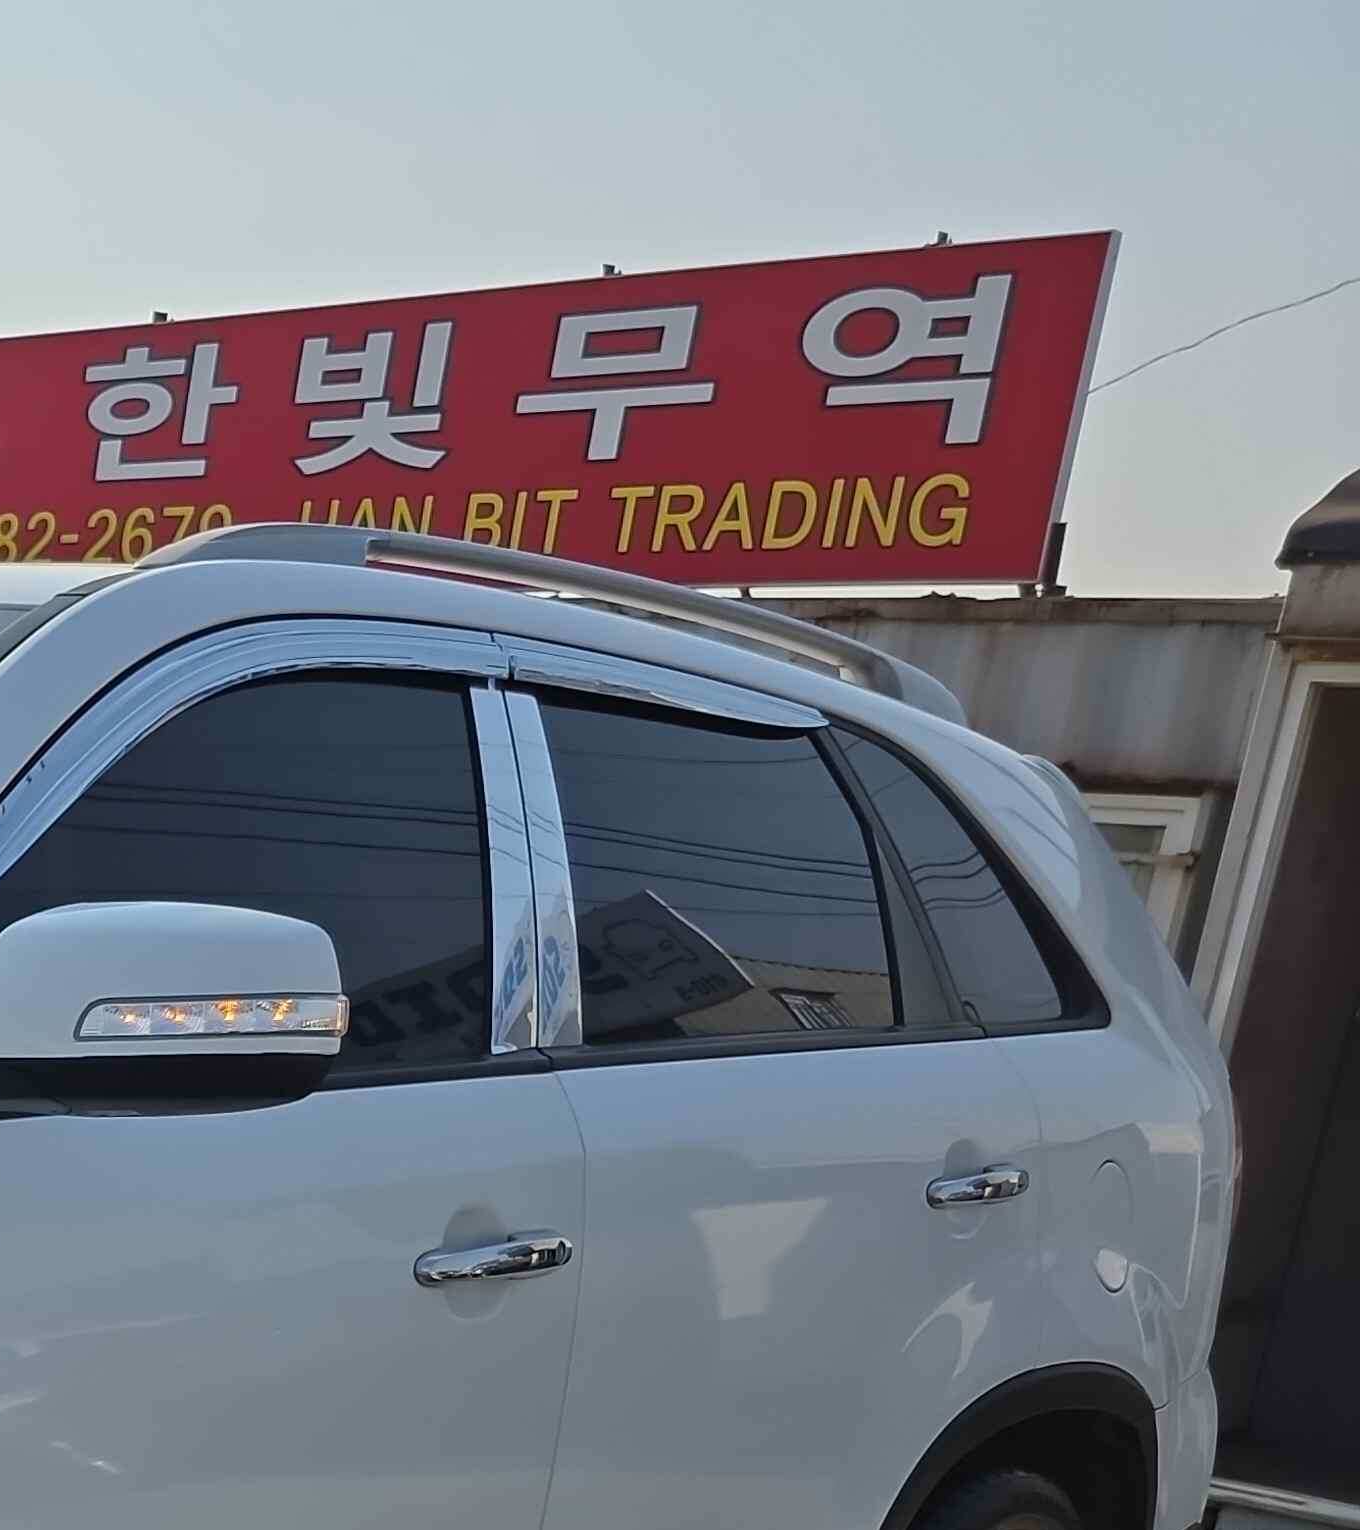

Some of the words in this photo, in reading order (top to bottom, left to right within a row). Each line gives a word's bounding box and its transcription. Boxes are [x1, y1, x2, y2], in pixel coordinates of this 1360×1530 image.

[84, 273, 1013, 482] 한빛무역
[464, 489, 580, 554] BIT
[610, 473, 971, 553] TRADING
